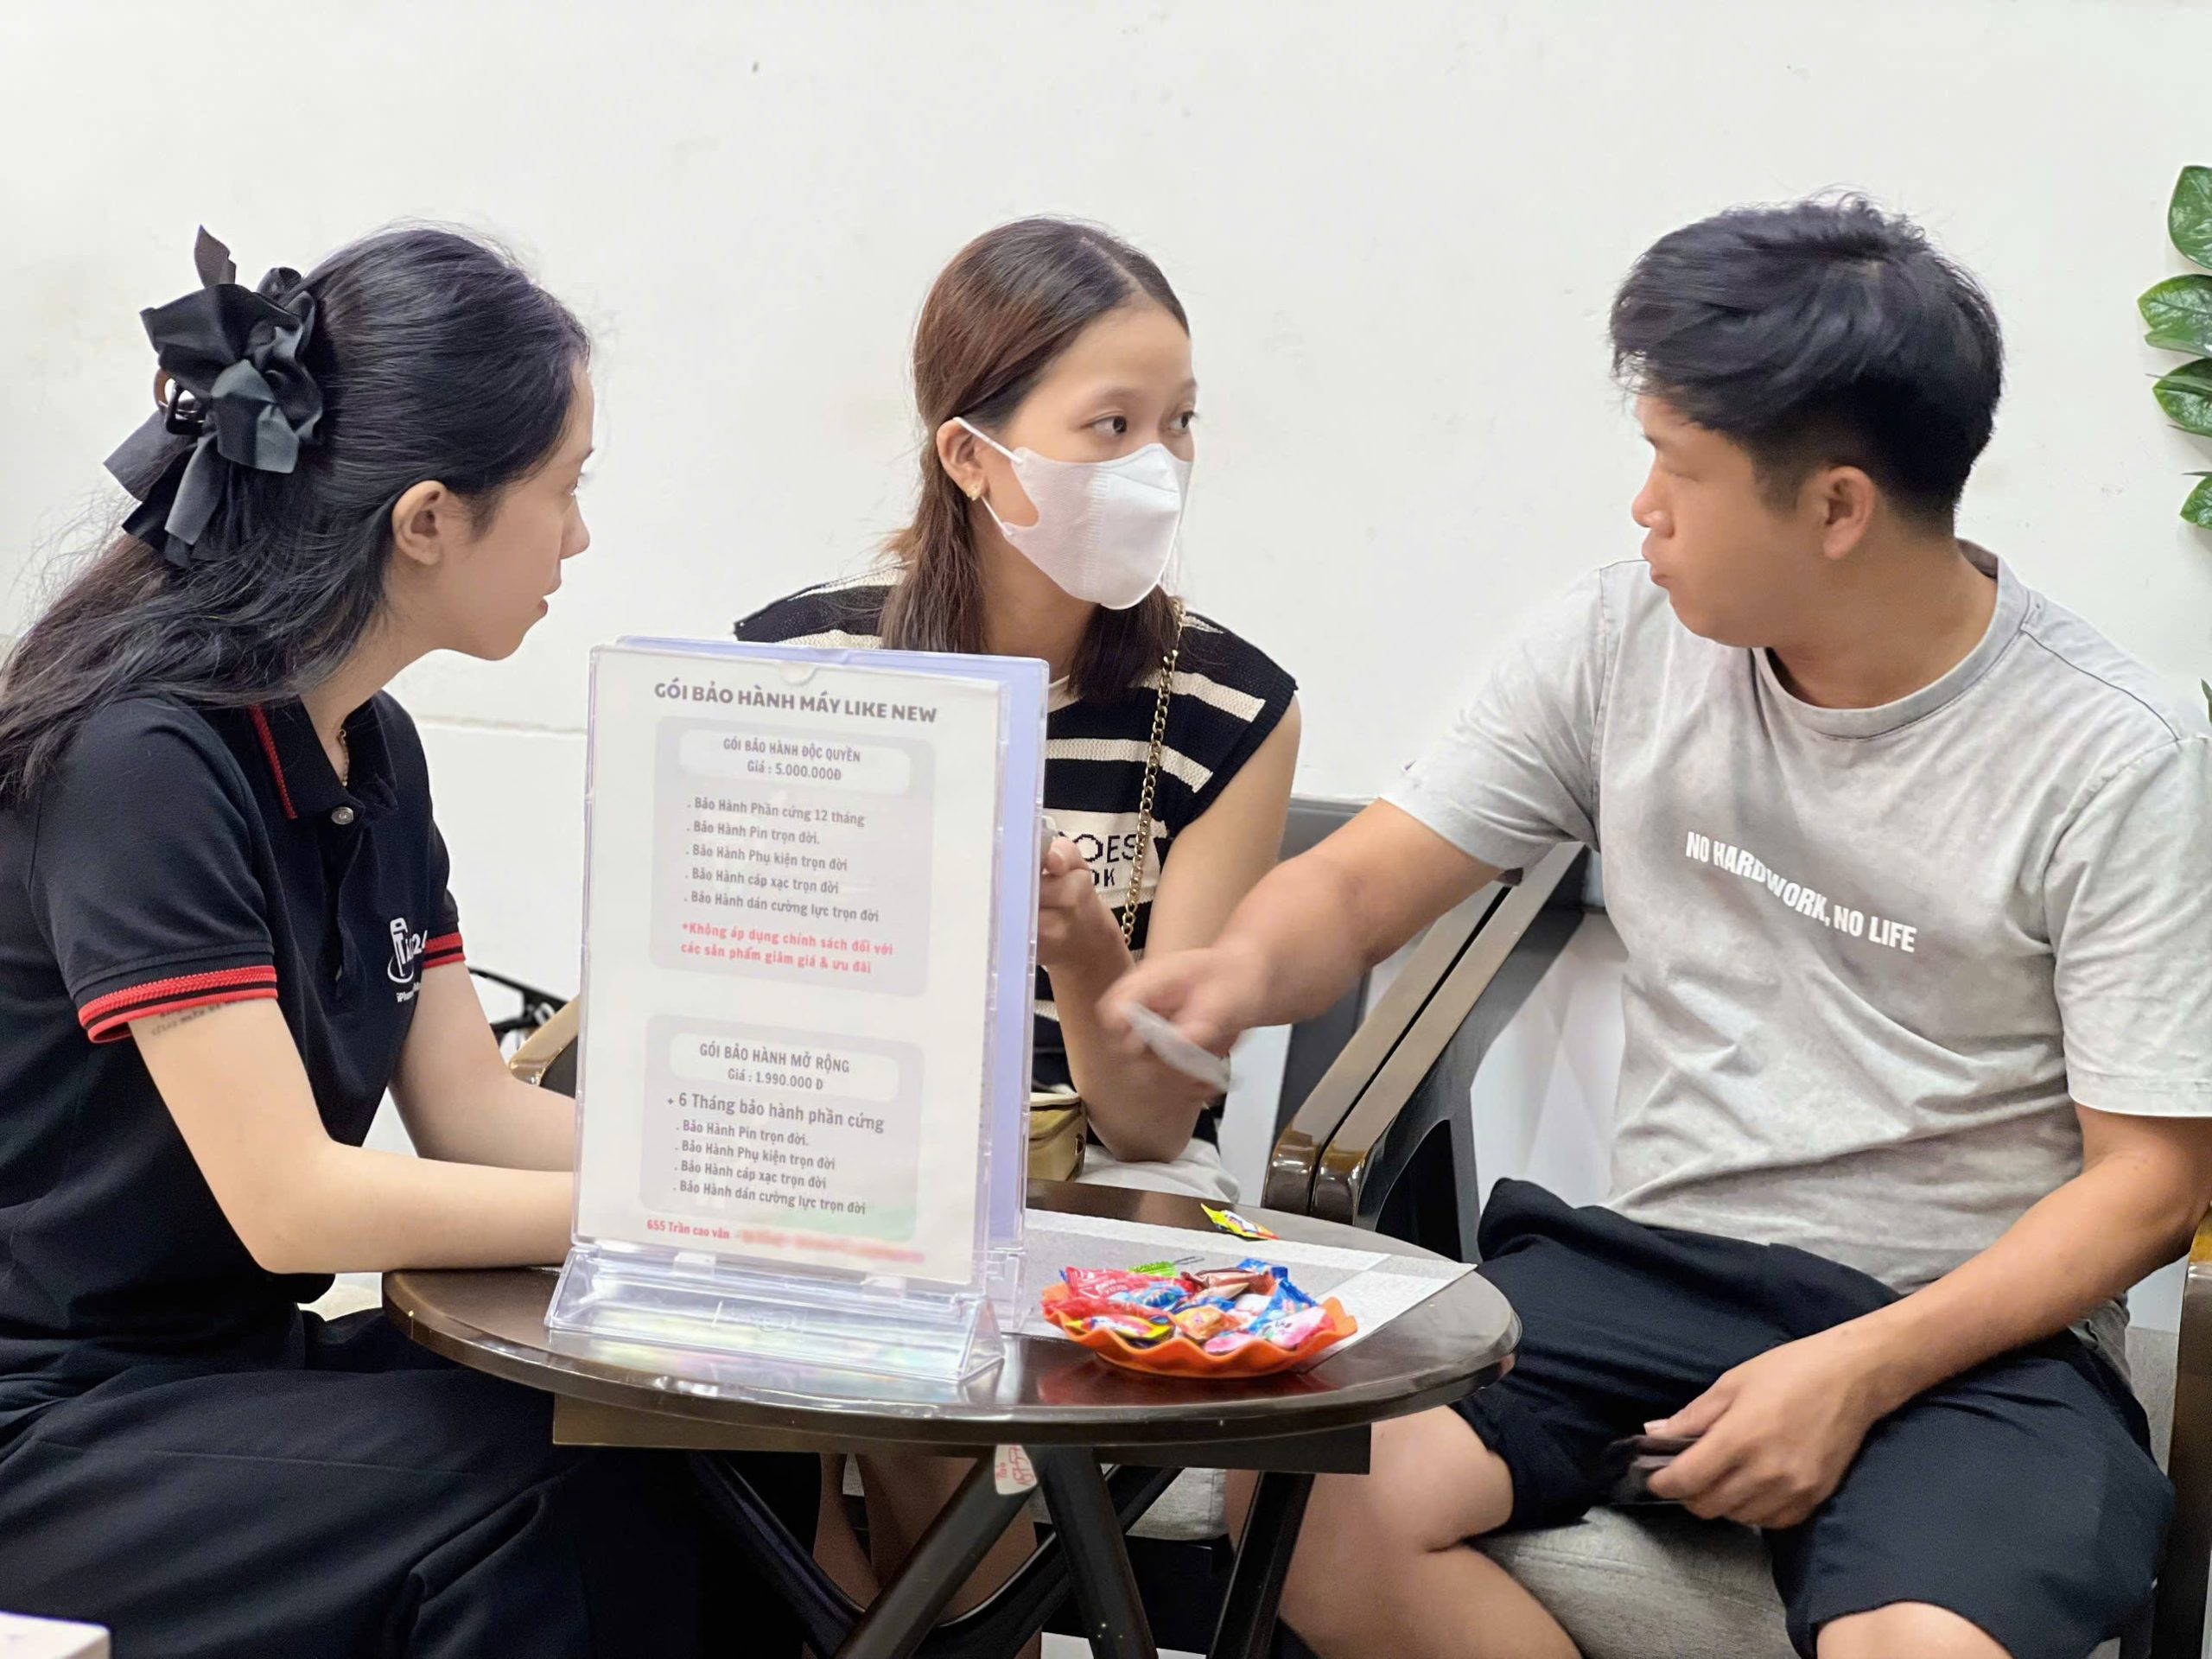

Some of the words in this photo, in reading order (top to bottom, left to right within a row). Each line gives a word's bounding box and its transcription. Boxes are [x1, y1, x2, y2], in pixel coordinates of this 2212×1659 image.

[654, 677, 687, 700] GÓI
[692, 680, 734, 703] BẢO
[738, 684, 795, 709] HÀNH
[800, 690, 840, 714] MÁY
[845, 700, 887, 718] LIKE
[892, 704, 937, 723] NEW
[723, 736, 741, 751] GÓI
[745, 738, 766, 753] BẢO
[770, 740, 798, 756] HÀNH
[802, 742, 822, 760] ĐỘC
[826, 746, 861, 762] QUYỀN
[747, 760, 765, 773] Giá
[775, 763, 842, 780] 5.000.000Đ
[695, 797, 715, 810] Bảo
[719, 799, 747, 813] Hành
[751, 802, 778, 816] Phần
[782, 805, 810, 822] cứng
[815, 810, 828, 821] 12
[831, 811, 865, 827] tháng
[694, 821, 714, 834] Bảo
[718, 823, 746, 836] Hành
[750, 826, 767, 839] Pin
[772, 830, 795, 843] trọn
[693, 844, 713, 857] Bảo
[716, 846, 745, 861] Hành
[748, 849, 770, 865] Phụ
[774, 852, 798, 868] kiện
[802, 857, 825, 871] trọn
[829, 858, 848, 871] đời
[692, 868, 712, 880] Bảo
[716, 869, 744, 884] Hành
[748, 874, 767, 888] cáp
[793, 880, 817, 893] trọn
[821, 881, 839, 894] đời
[1686, 831, 1709, 862] NO
[1834, 905, 1864, 937] NO
[1868, 916, 1917, 952] LIFE
[691, 891, 711, 904] Bảo
[715, 893, 743, 907] Hành
[747, 897, 767, 910] dán
[832, 907, 856, 922] trọn
[861, 909, 879, 922] đời
[731, 925, 744, 940] áp
[749, 930, 779, 944] dụng
[783, 933, 816, 947] chính
[821, 938, 848, 950] sách
[874, 943, 893, 956] với
[681, 941, 701, 954] các
[704, 944, 725, 957] sản
[765, 950, 793, 964] giảm
[798, 954, 816, 968] giá
[820, 957, 828, 969] &
[833, 960, 849, 971] ưu
[700, 1041, 720, 1058] GÓI
[725, 1043, 748, 1060] BẢO
[753, 1046, 786, 1065] HÀNH
[791, 1052, 811, 1068] MỞ
[816, 1054, 849, 1074] RỘNG
[728, 1068, 745, 1081] Giá
[756, 1071, 812, 1089] 1.990.000
[679, 1092, 687, 1107] 6
[691, 1093, 734, 1115] Tháng
[740, 1099, 765, 1116] bảo
[769, 1102, 804, 1121] hành
[809, 1107, 843, 1125] phần
[848, 1112, 885, 1134] cứng
[683, 1119, 703, 1133] Bảo
[707, 1122, 734, 1137] Hành
[739, 1126, 757, 1139] Pin
[760, 1130, 784, 1145] trọn
[682, 1140, 702, 1153] Bảo
[705, 1143, 734, 1157] Hành
[738, 1147, 759, 1163] Phụ
[762, 1149, 786, 1166] kiện
[790, 1154, 813, 1169] trọn
[817, 1156, 835, 1170] đời
[681, 1160, 701, 1173] Bảo
[705, 1163, 733, 1178] Hành
[736, 1167, 755, 1182] cáp
[781, 1174, 804, 1189] trọn
[808, 1175, 827, 1190] đời
[680, 1180, 700, 1193] Bảo
[703, 1183, 732, 1198] Hành
[735, 1186, 755, 1201] dán
[821, 1198, 844, 1213] trọn
[847, 1200, 866, 1215] đời
[646, 1219, 665, 1231] 655
[693, 1227, 709, 1236] cao
